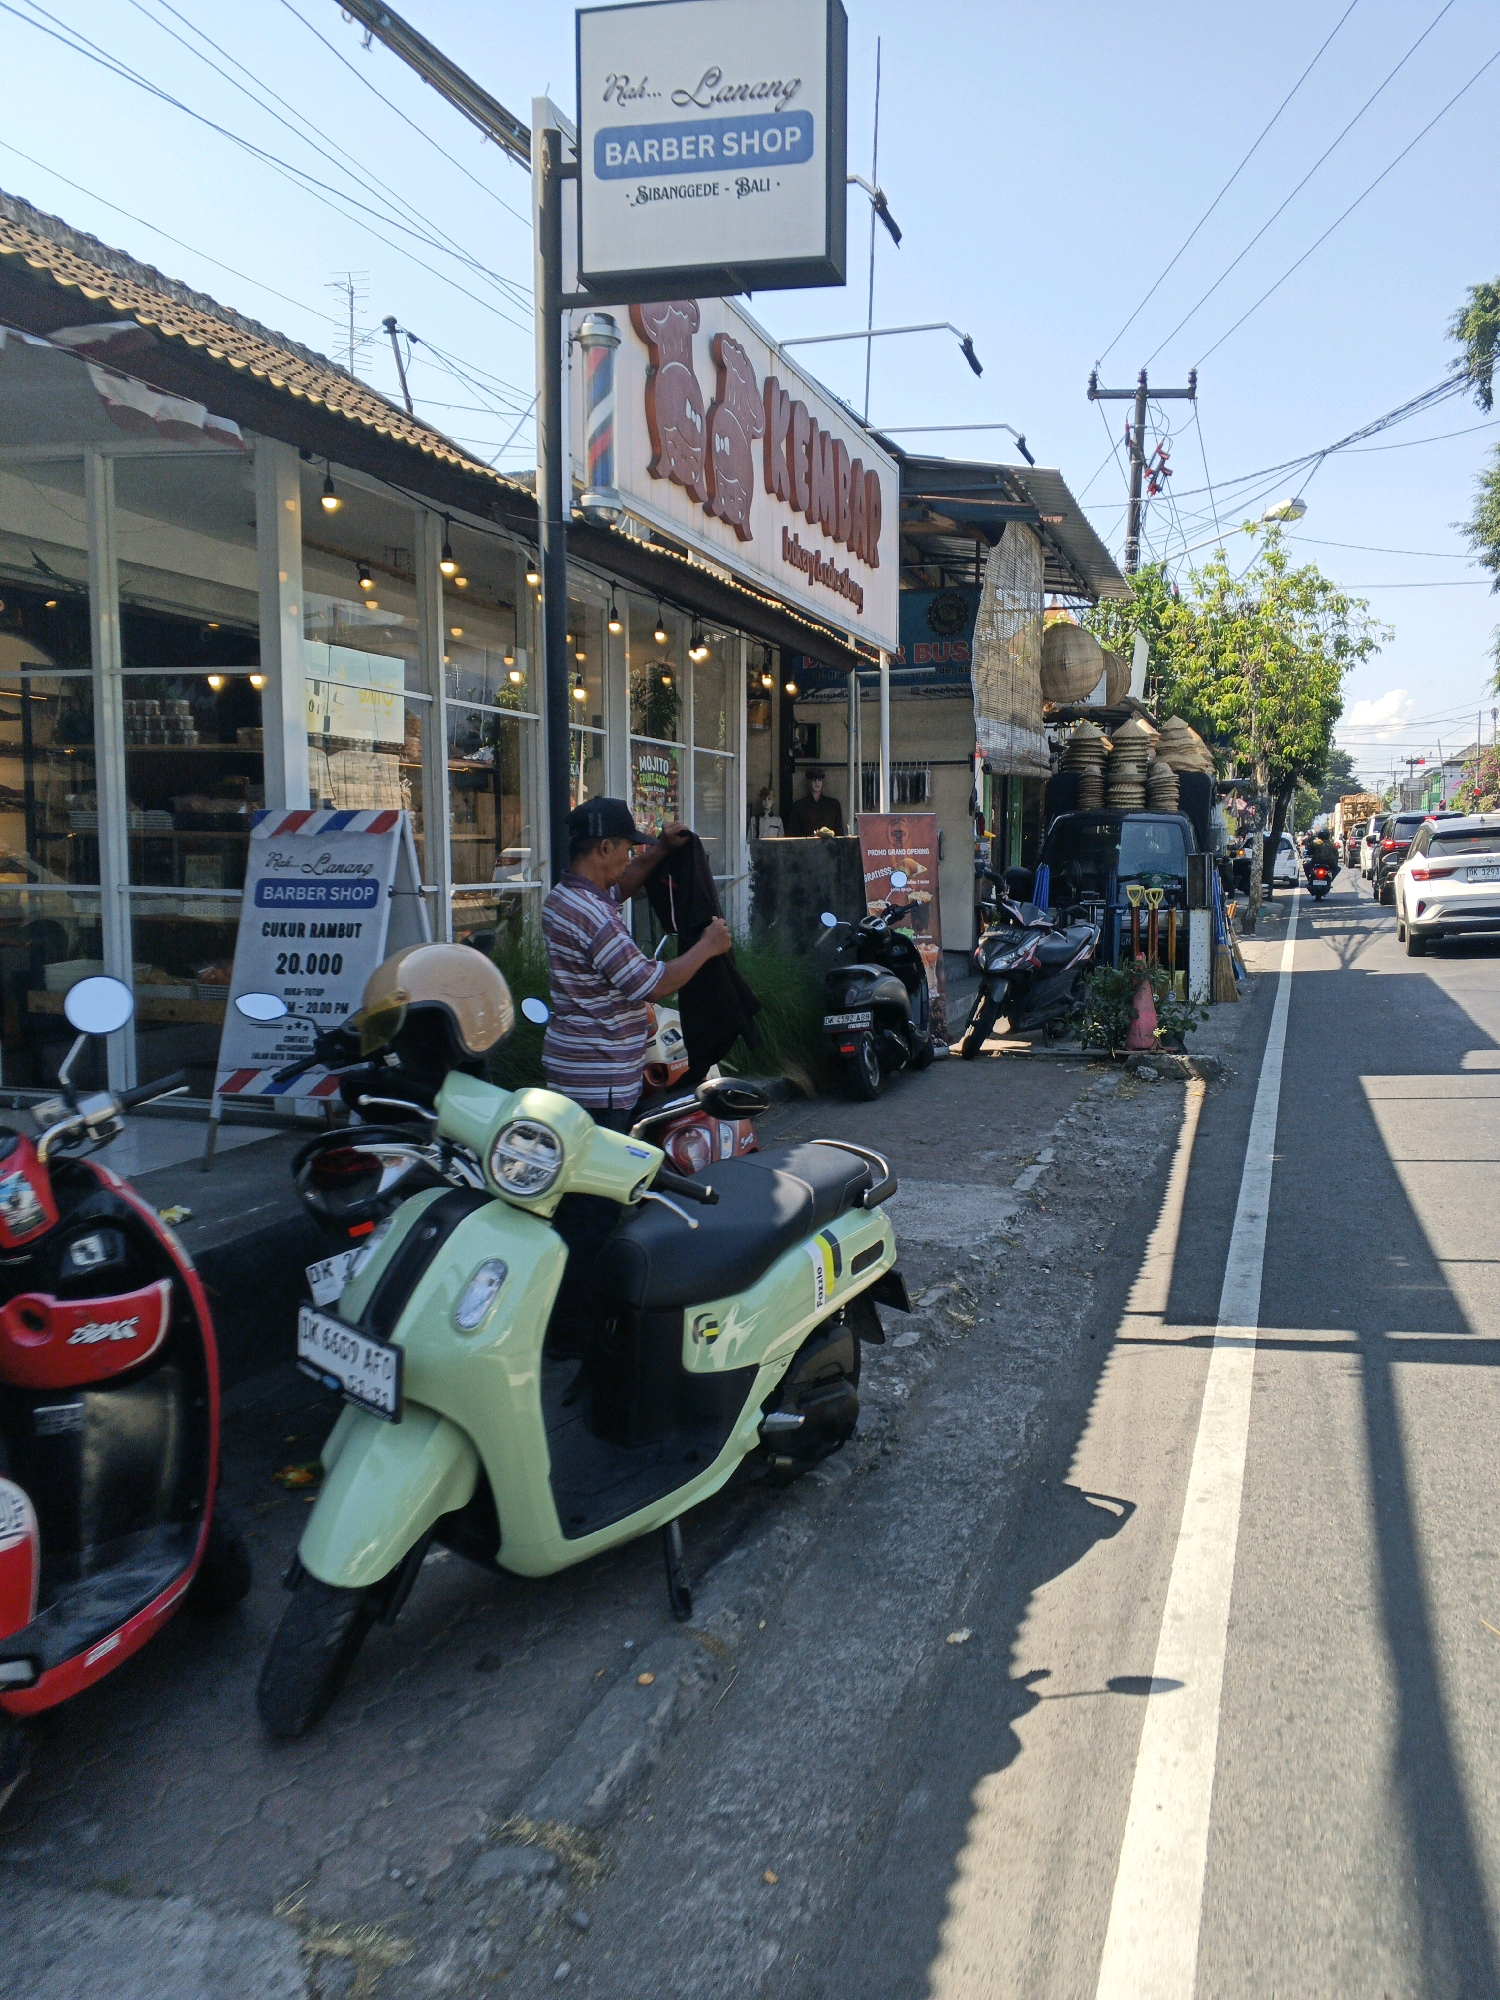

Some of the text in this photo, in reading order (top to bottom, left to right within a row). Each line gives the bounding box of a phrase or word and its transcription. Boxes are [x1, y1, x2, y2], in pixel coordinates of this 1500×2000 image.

[671, 66, 801, 112] Lanang
[605, 126, 801, 166] BARBER SHOP
[763, 376, 881, 568] KEMBAR
[639, 755, 669, 775] MOJITO
[301, 853, 374, 880] Lanang
[263, 886, 374, 900] BARBER SHOP
[262, 921, 362, 938] CUKUR RAMBUT
[334, 1003, 349, 1013] PM
[309, 1260, 333, 1284] DK
[302, 1315, 320, 1346] DK
